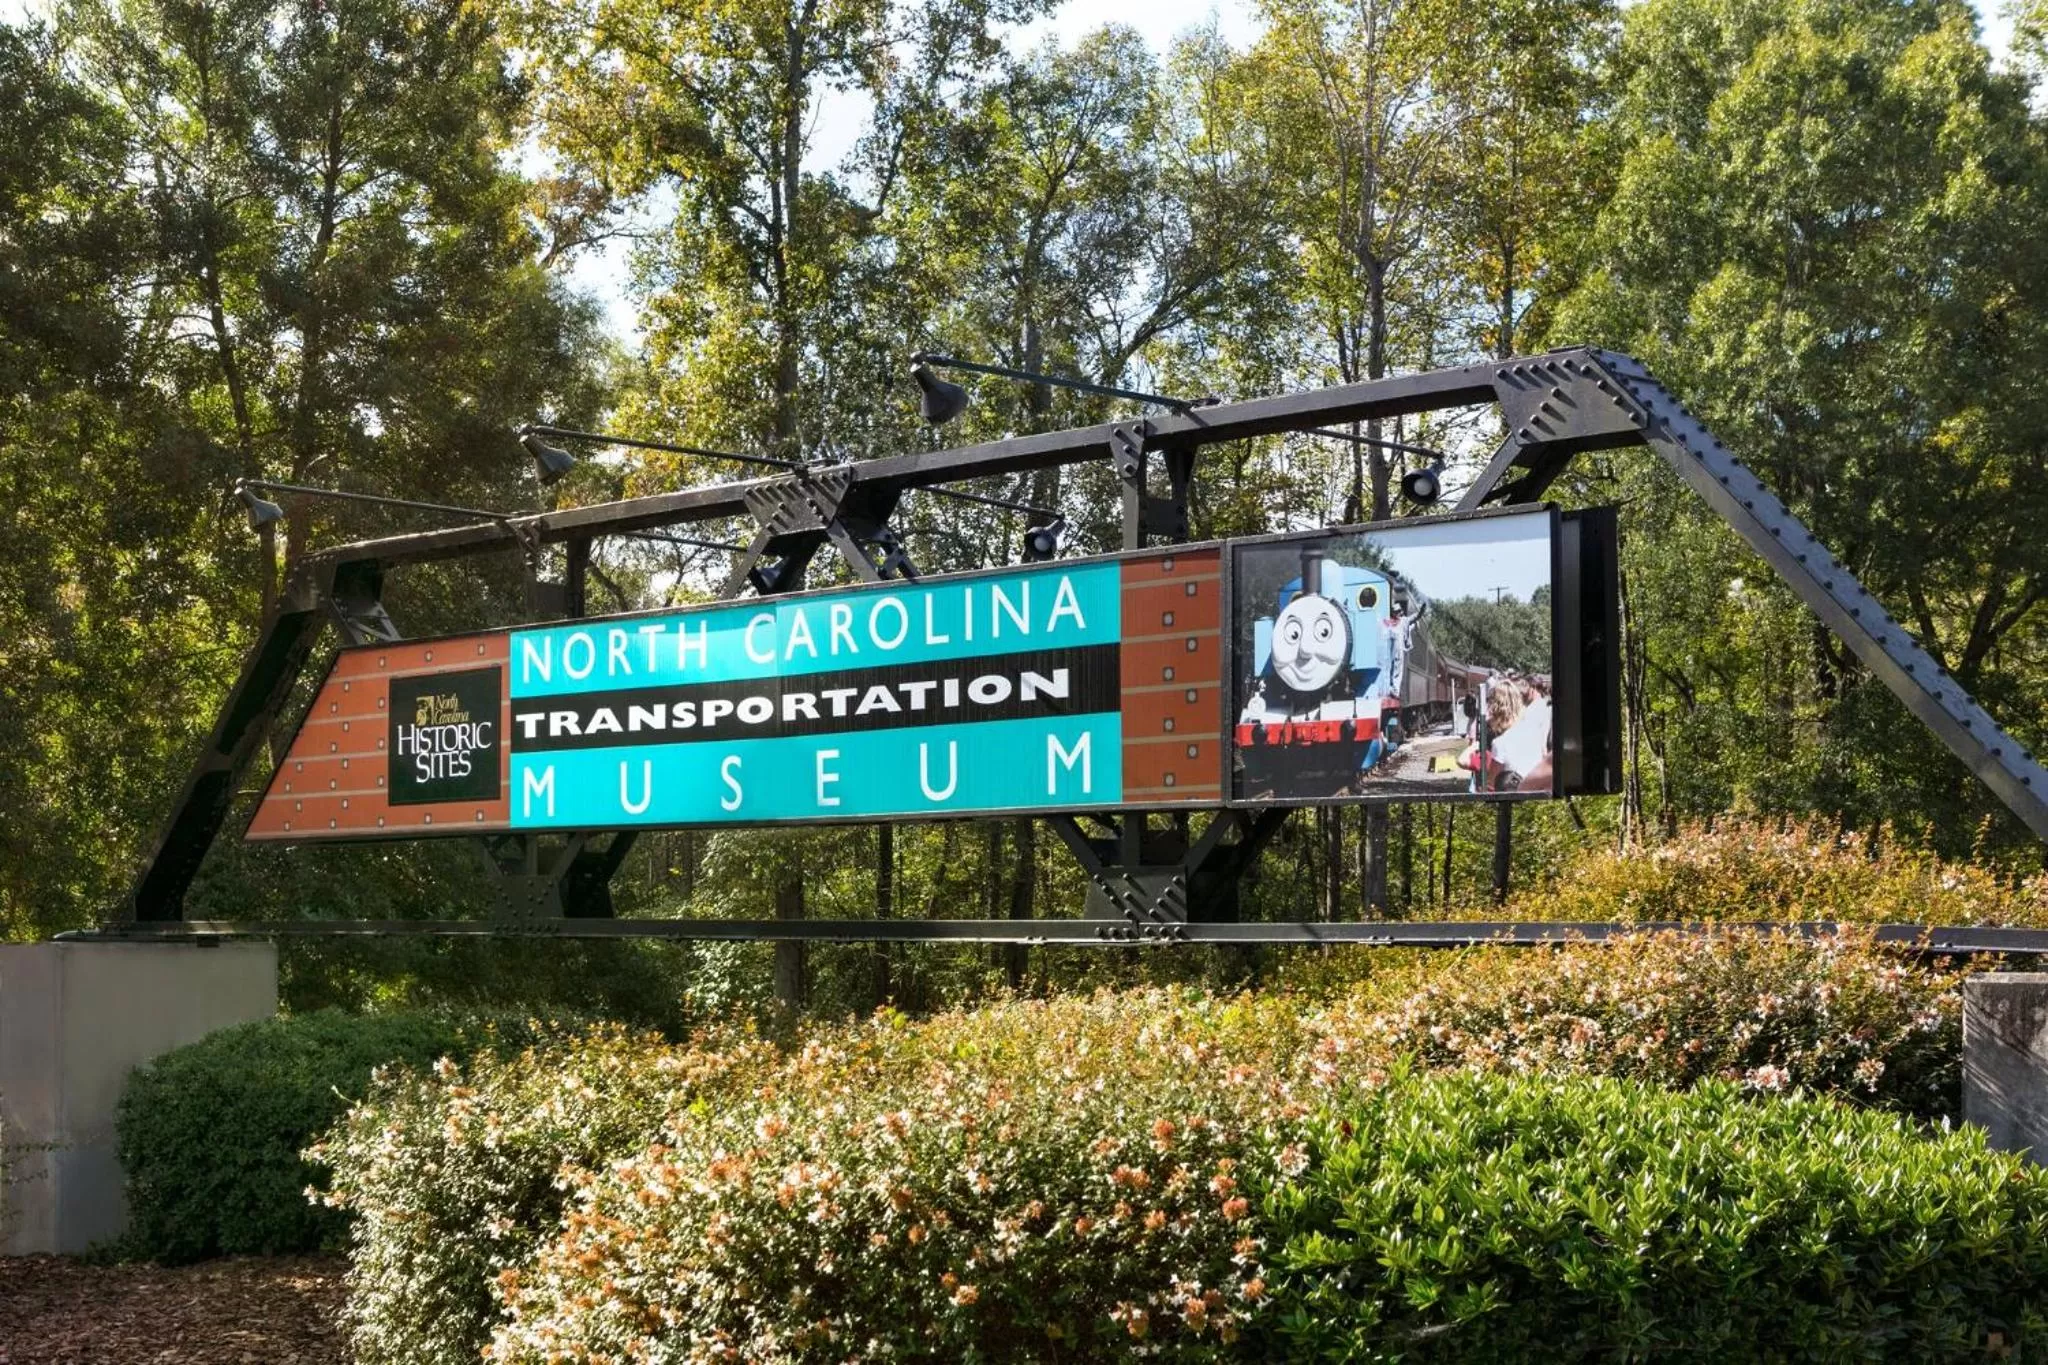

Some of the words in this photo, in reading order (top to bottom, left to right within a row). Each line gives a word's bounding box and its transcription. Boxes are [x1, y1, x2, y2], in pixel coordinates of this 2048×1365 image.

[523, 619, 708, 684] NORTH
[744, 575, 1087, 664] CAROLINA
[397, 721, 492, 755] HISTORIC
[515, 668, 1070, 739] TRANSPORTATION
[415, 750, 472, 783] SITES
[523, 730, 1092, 818] MUSEUM
